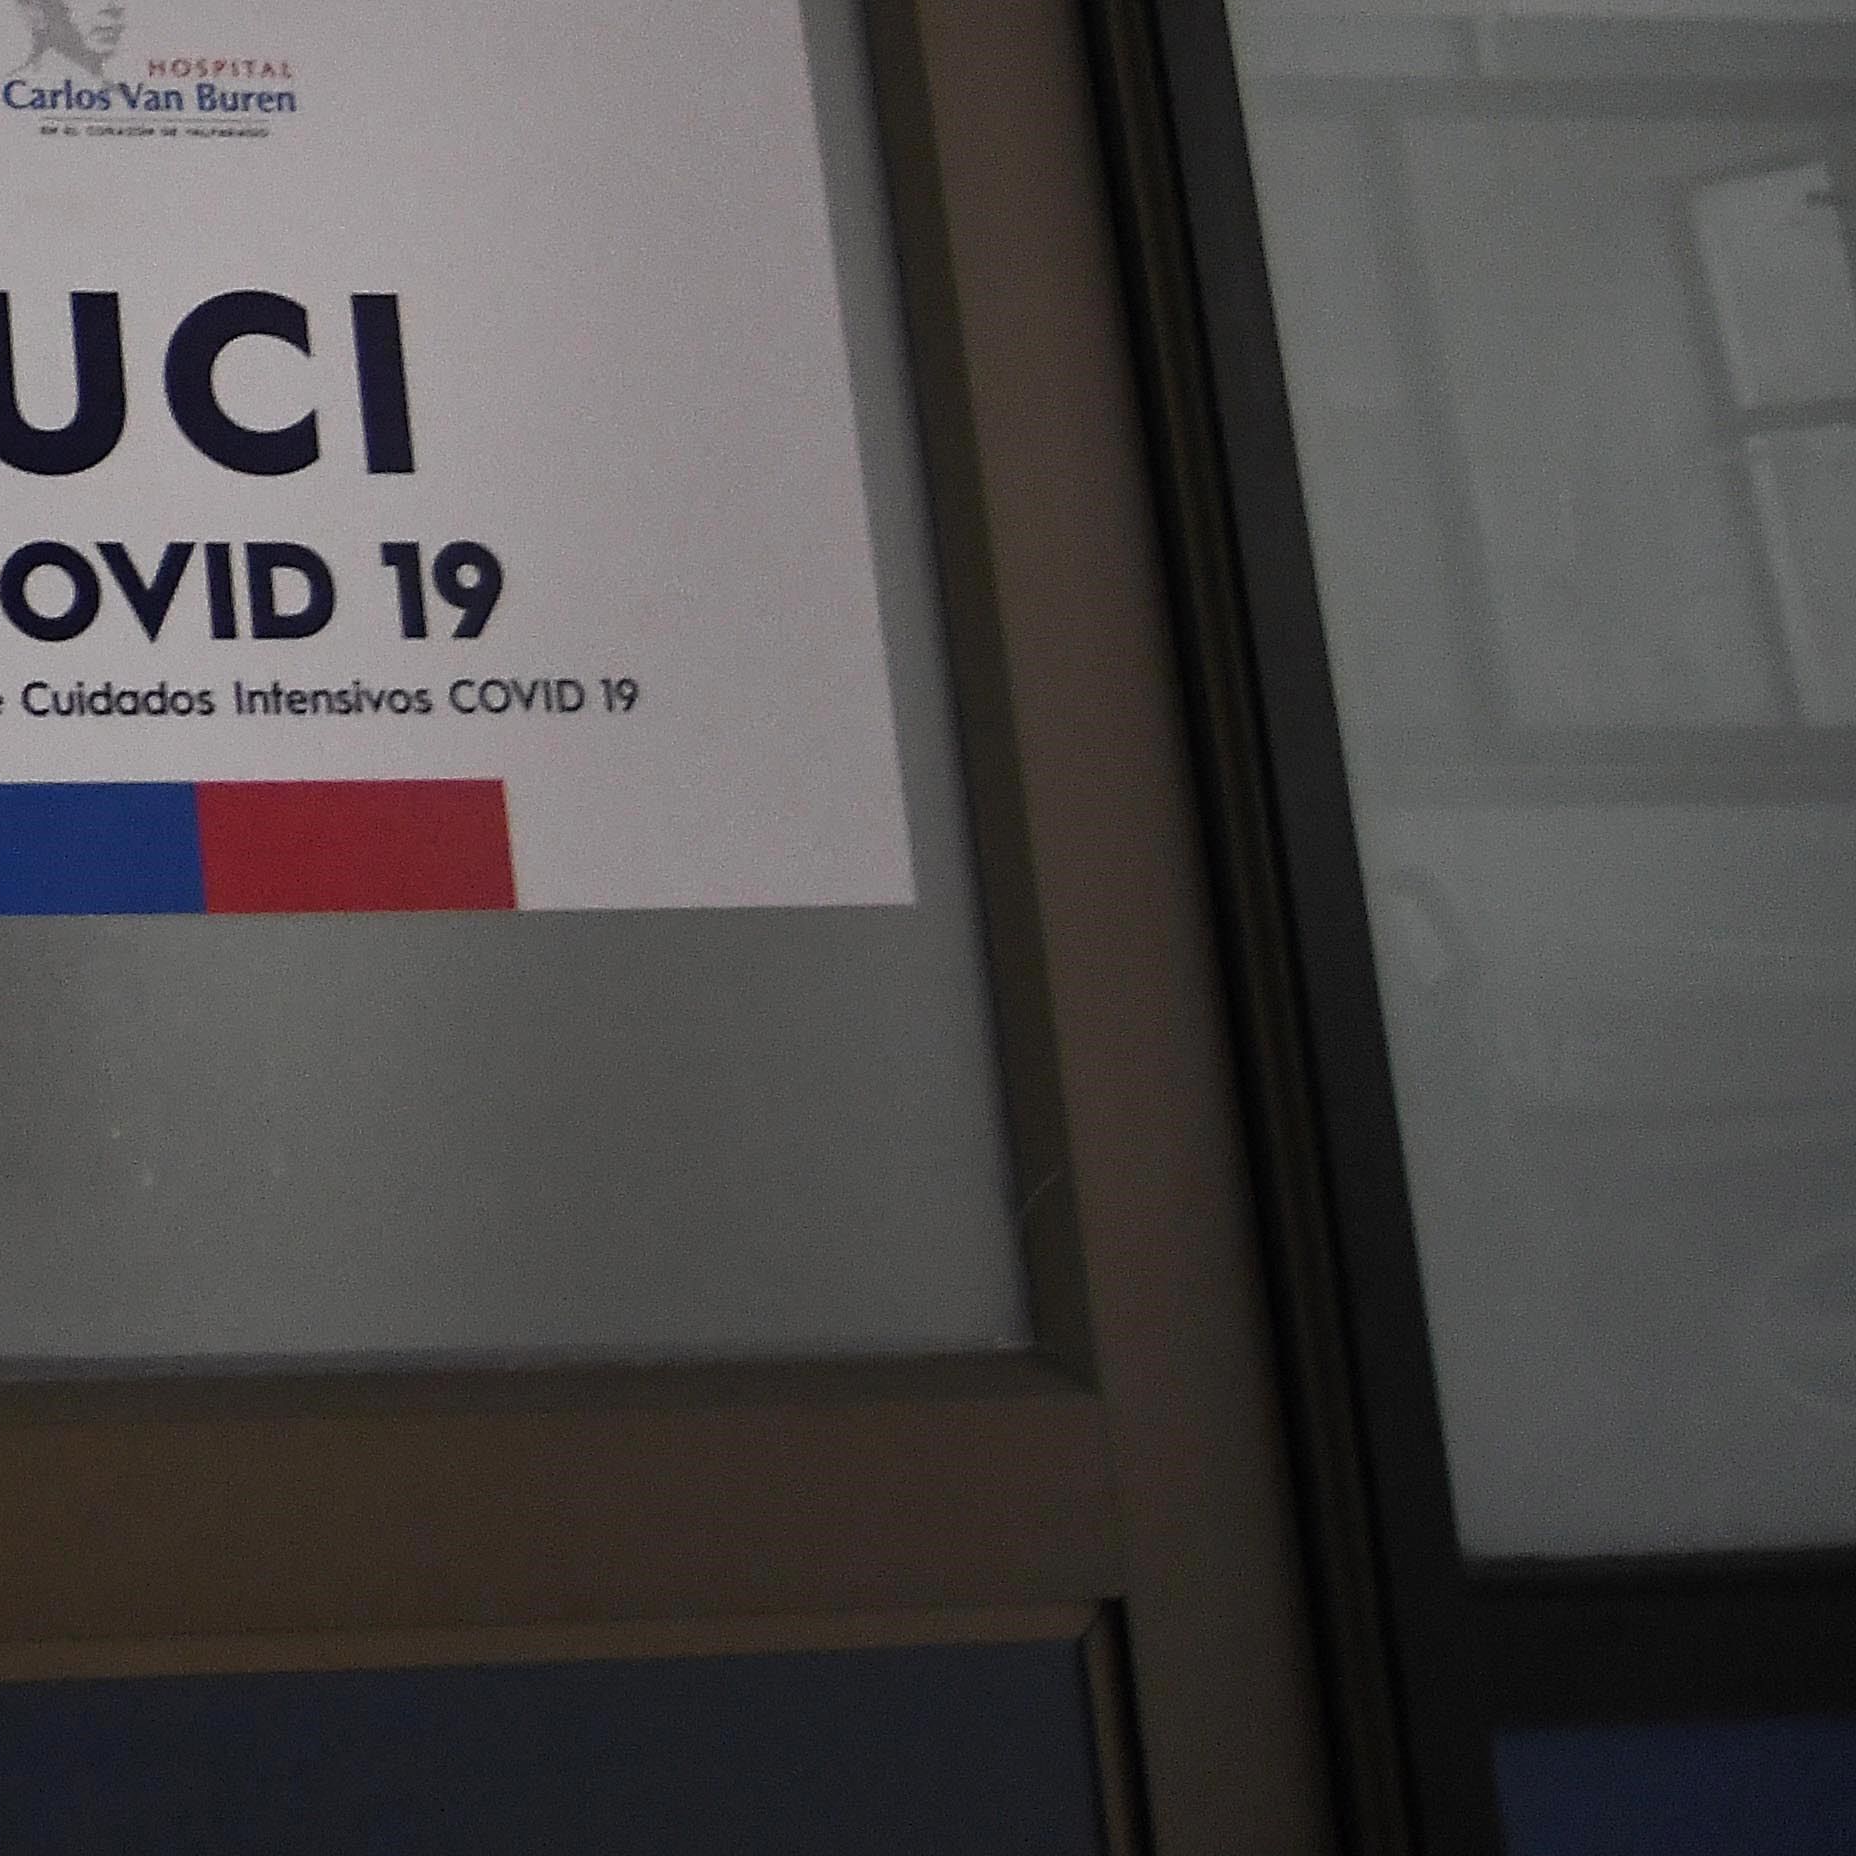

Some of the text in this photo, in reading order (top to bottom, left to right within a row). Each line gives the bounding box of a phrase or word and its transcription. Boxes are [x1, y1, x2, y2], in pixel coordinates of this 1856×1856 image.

[147, 57, 294, 80] HOSPITAL
[1, 79, 298, 113] Carlos Van Buren
[380, 540, 504, 642] 19
[21, 680, 216, 718] Cuidados
[234, 679, 434, 717] Intensivos
[448, 678, 587, 715] COVID
[599, 677, 641, 715] 19
